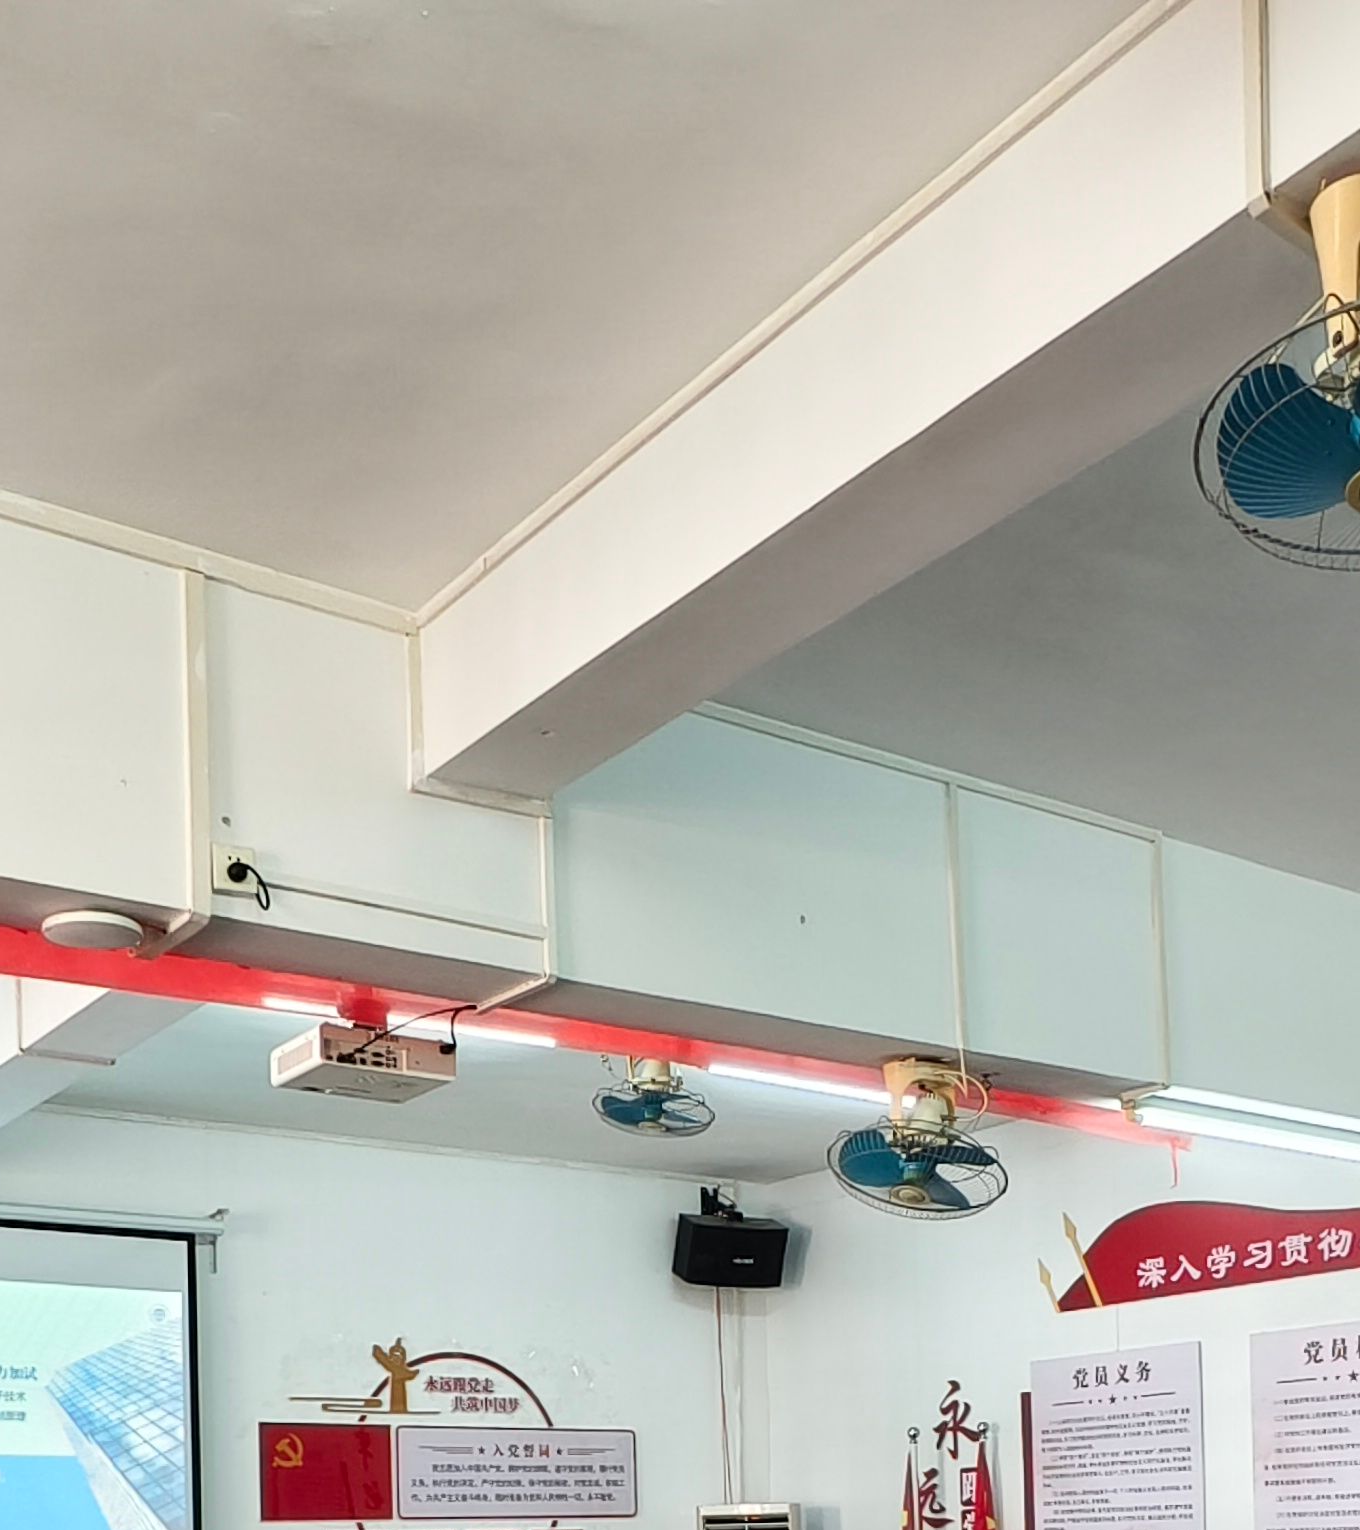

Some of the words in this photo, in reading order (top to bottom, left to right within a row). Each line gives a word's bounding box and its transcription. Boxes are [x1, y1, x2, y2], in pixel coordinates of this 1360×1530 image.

[424, 1375, 495, 1394] 永远跟党走
[1072, 1359, 1152, 1390] 党员义务
